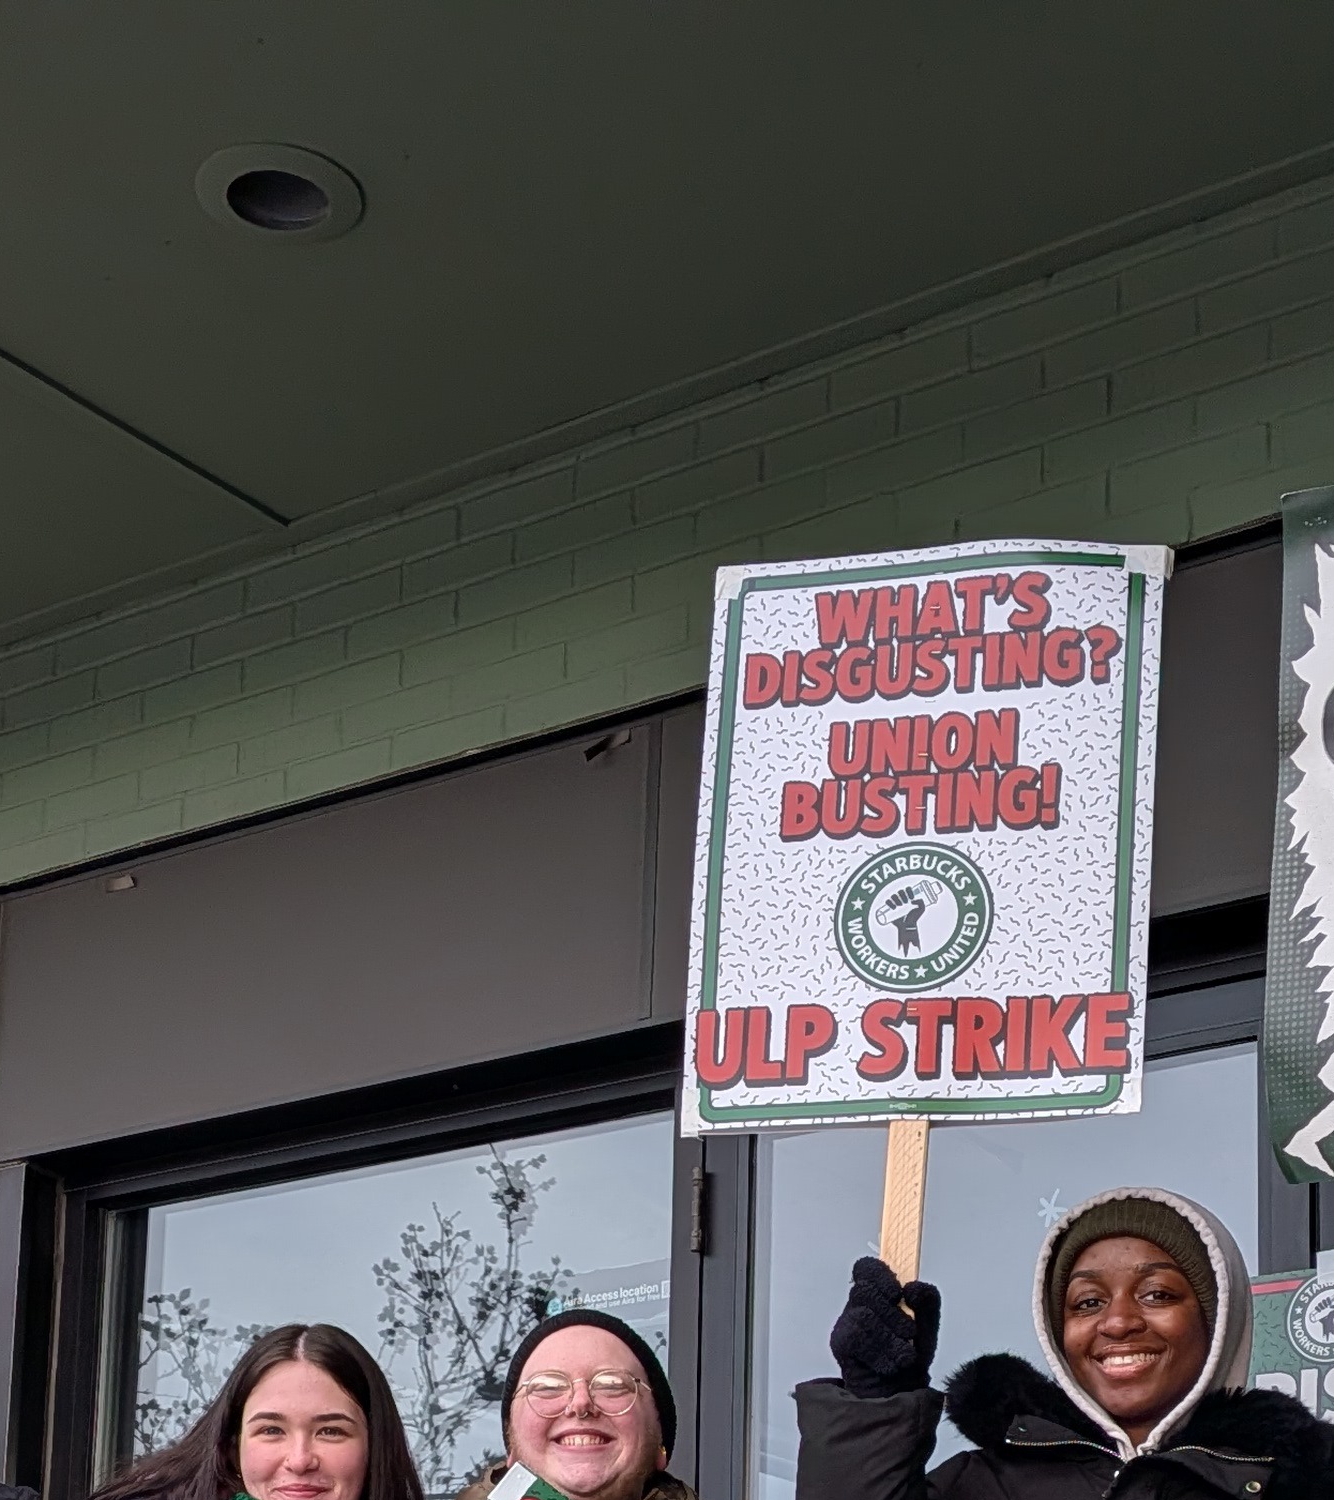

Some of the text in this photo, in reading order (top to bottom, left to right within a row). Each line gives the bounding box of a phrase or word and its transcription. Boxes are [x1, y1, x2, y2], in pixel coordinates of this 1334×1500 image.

[815, 572, 1051, 645] WHAT'S
[743, 625, 1121, 710] DISGUSTING?
[828, 708, 1019, 780] UNION
[780, 763, 1061, 842] BUSTING!
[860, 855, 972, 895] STARBUCKS
[847, 911, 980, 980] WORKERS UNITED
[696, 992, 1133, 1088] ULP STRIKE
[584, 1290, 618, 1304] Access
[619, 1283, 659, 1299] location
[1293, 1318, 1330, 1356] WORKERS
